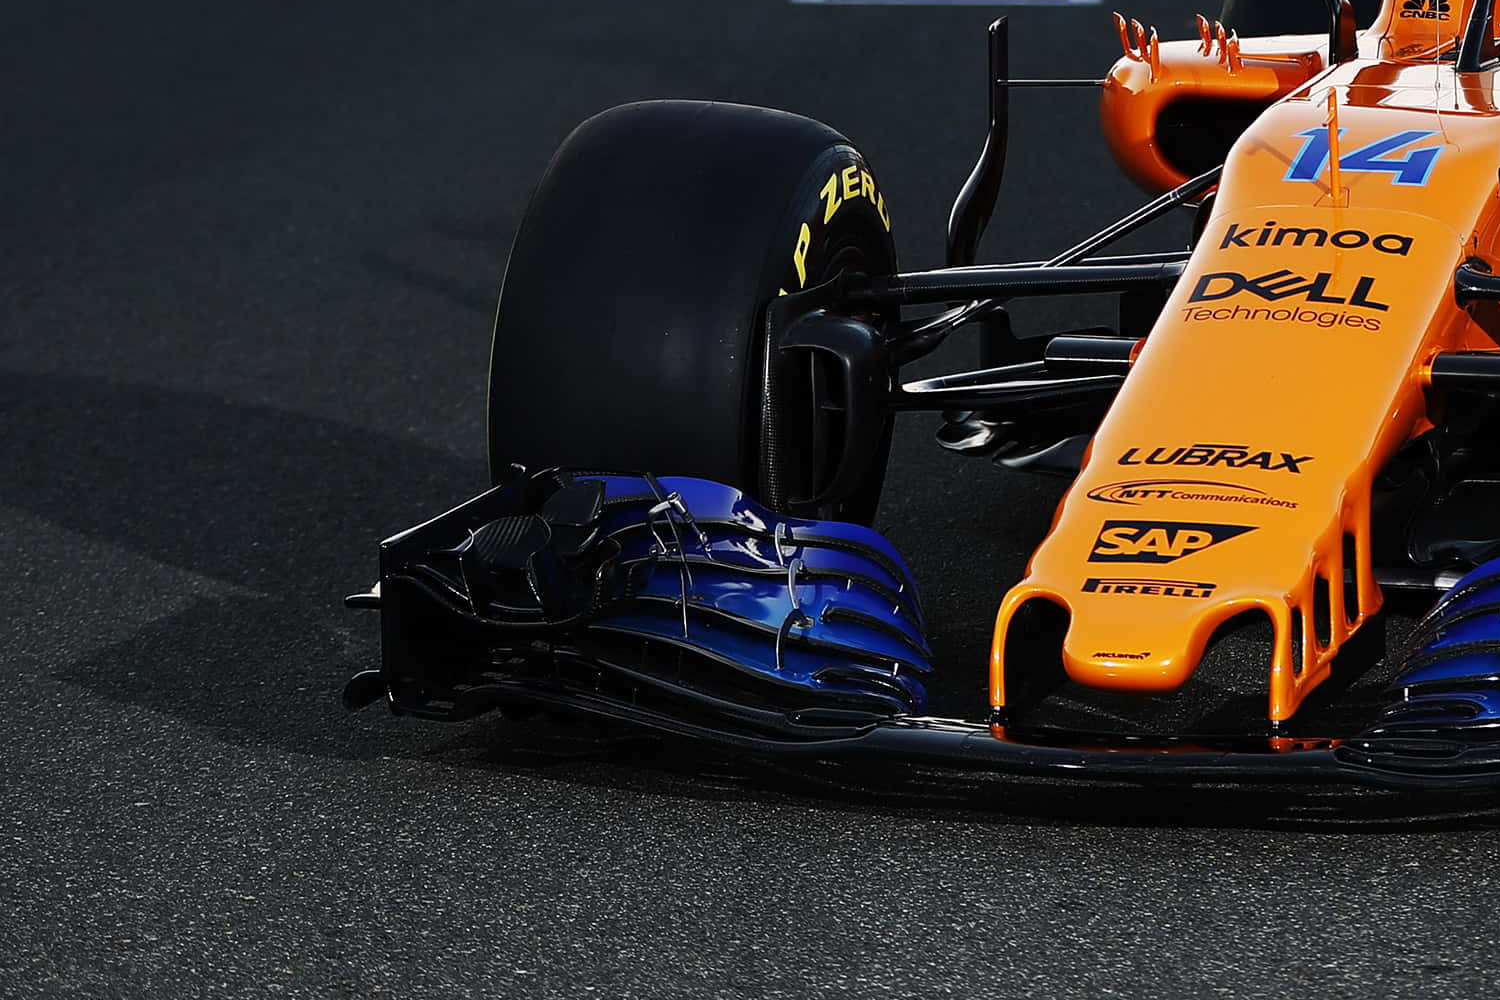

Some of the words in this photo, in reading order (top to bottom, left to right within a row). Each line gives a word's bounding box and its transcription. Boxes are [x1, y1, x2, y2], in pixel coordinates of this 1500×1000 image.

[1399, 10, 1451, 21] CNBC
[1282, 127, 1447, 187] 14
[1219, 221, 1415, 256] kimoa
[1187, 269, 1390, 312] DELL
[1181, 304, 1382, 331] Technologies
[1117, 443, 1314, 473] LUBRAX
[1120, 489, 1173, 499] NTT
[1171, 490, 1299, 509] Communications
[1094, 526, 1214, 558] SAP
[1080, 578, 1217, 598] PIRELLI
